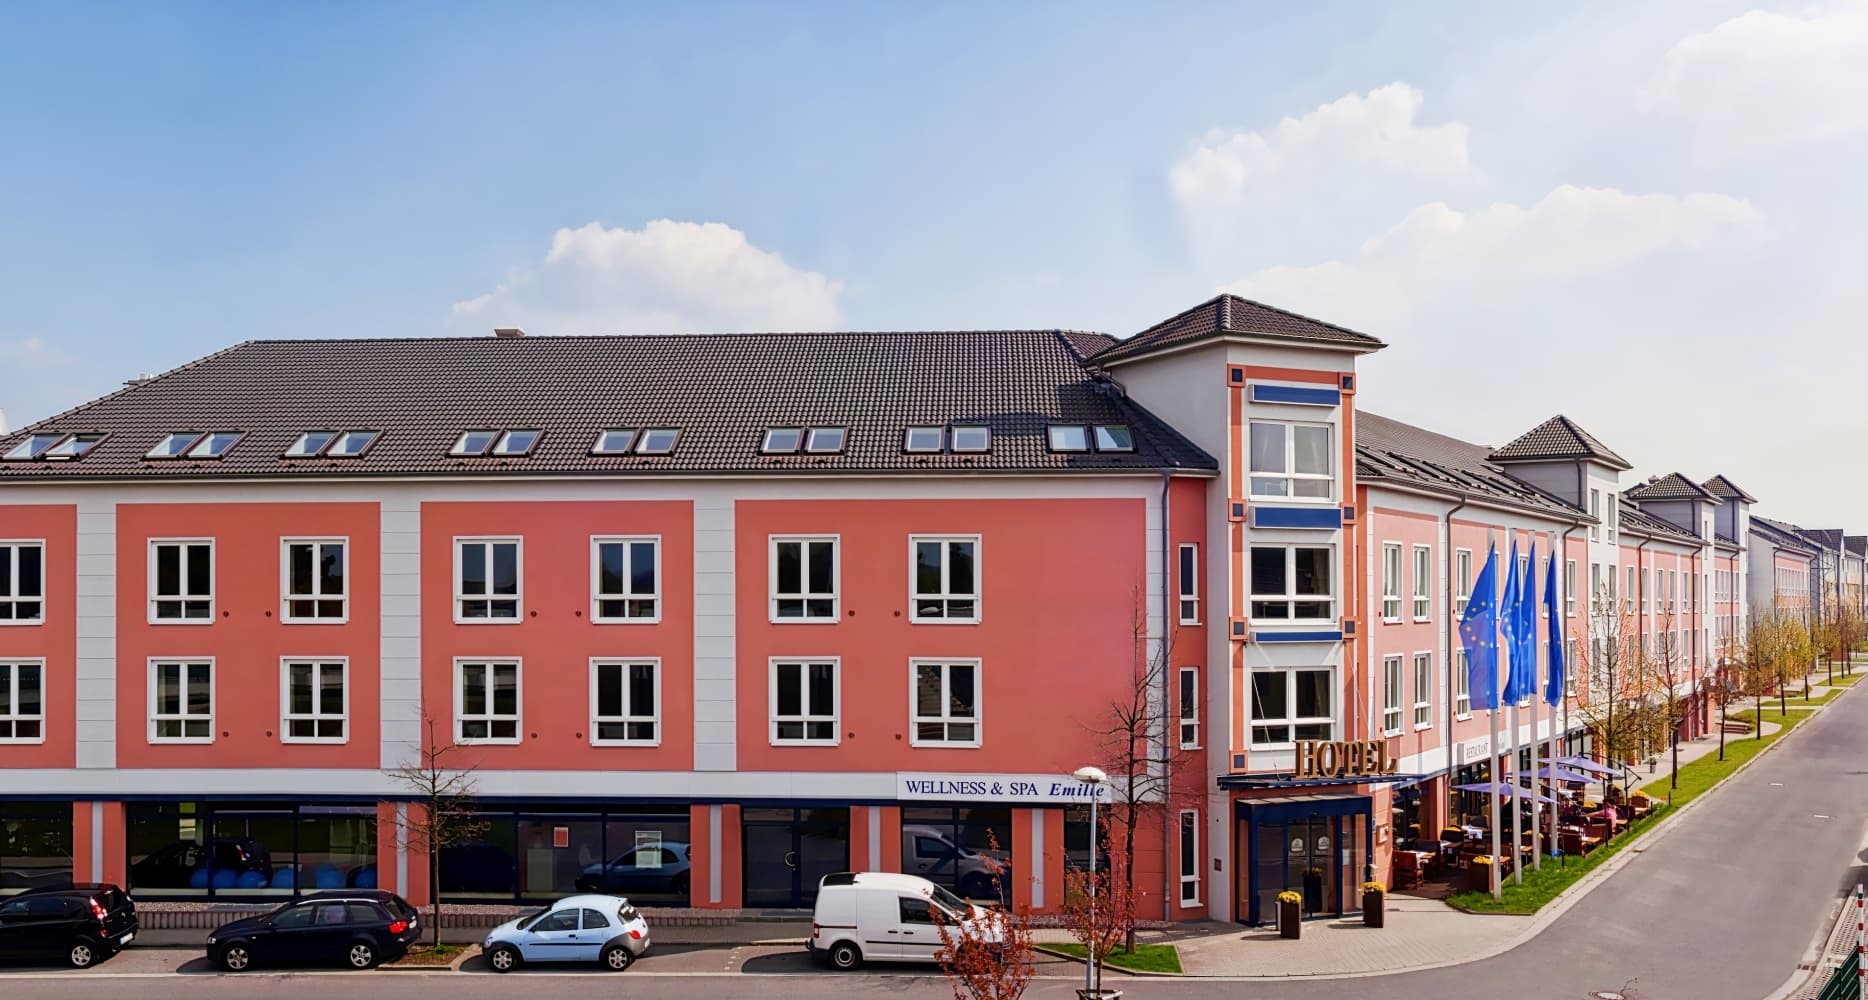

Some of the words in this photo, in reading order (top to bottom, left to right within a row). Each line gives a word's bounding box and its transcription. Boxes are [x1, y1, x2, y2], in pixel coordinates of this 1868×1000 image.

[1295, 740, 1398, 779] HOTEL
[905, 780, 987, 795] WELLNESS
[990, 781, 1004, 796] &
[1009, 782, 1040, 796] SPA
